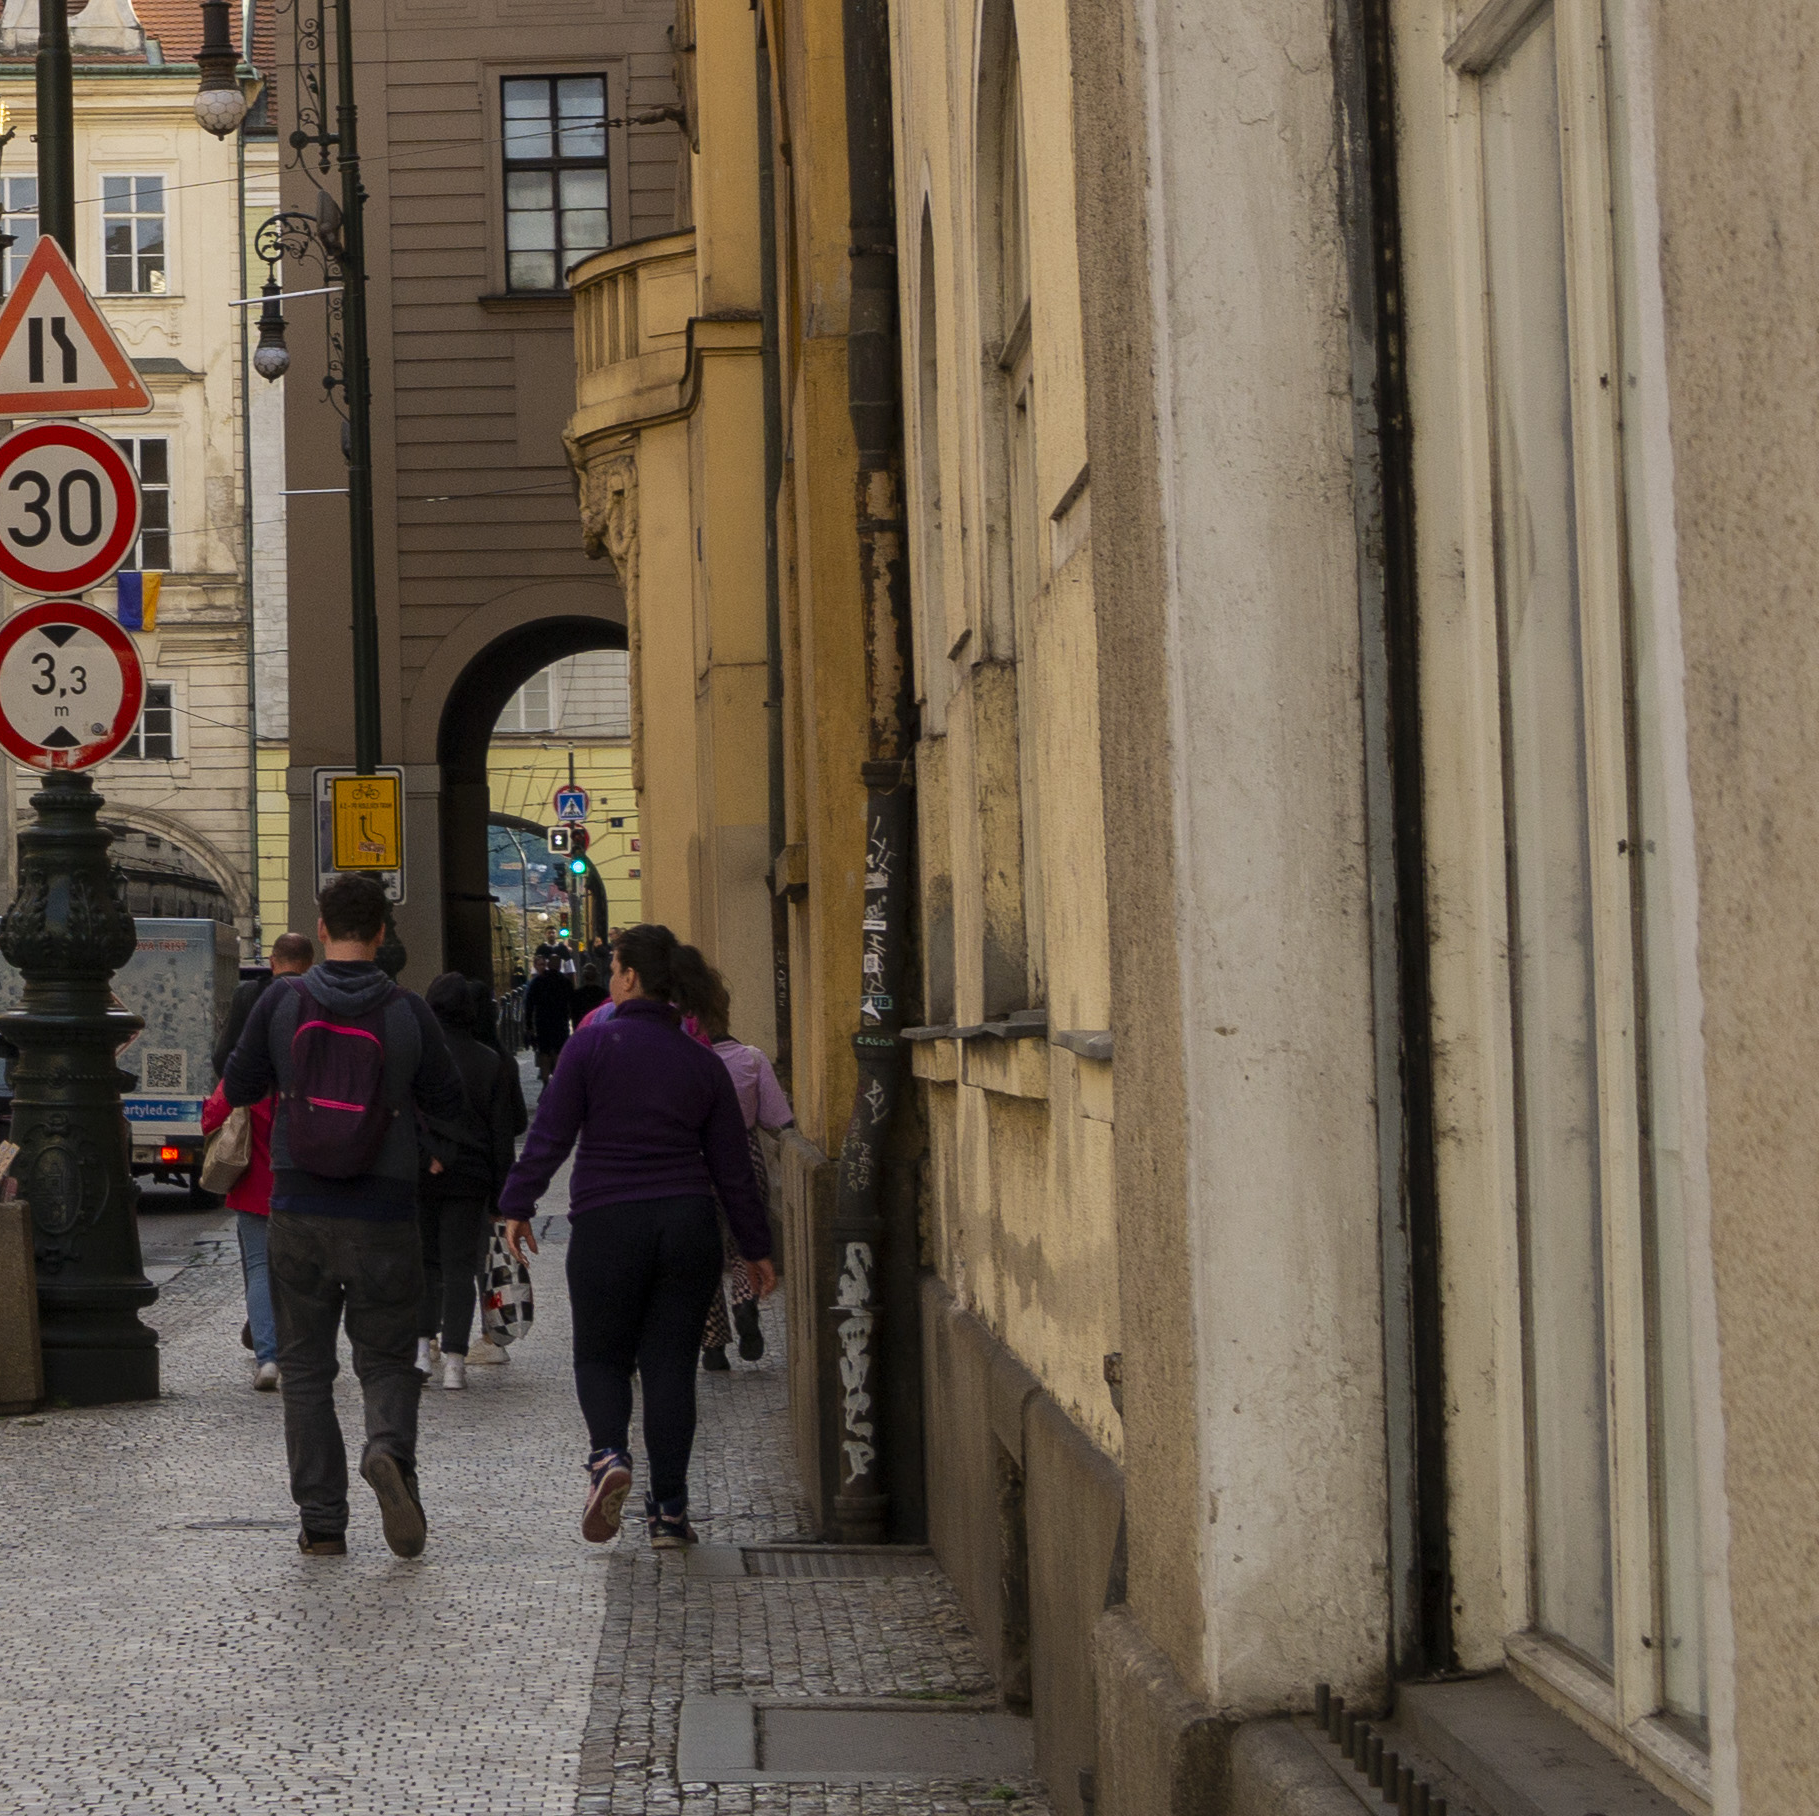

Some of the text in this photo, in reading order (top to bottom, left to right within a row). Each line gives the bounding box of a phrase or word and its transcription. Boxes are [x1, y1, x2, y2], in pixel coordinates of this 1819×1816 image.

[7, 469, 102, 547] 30
[31, 652, 87, 698] 3,3
[54, 706, 69, 717] m
